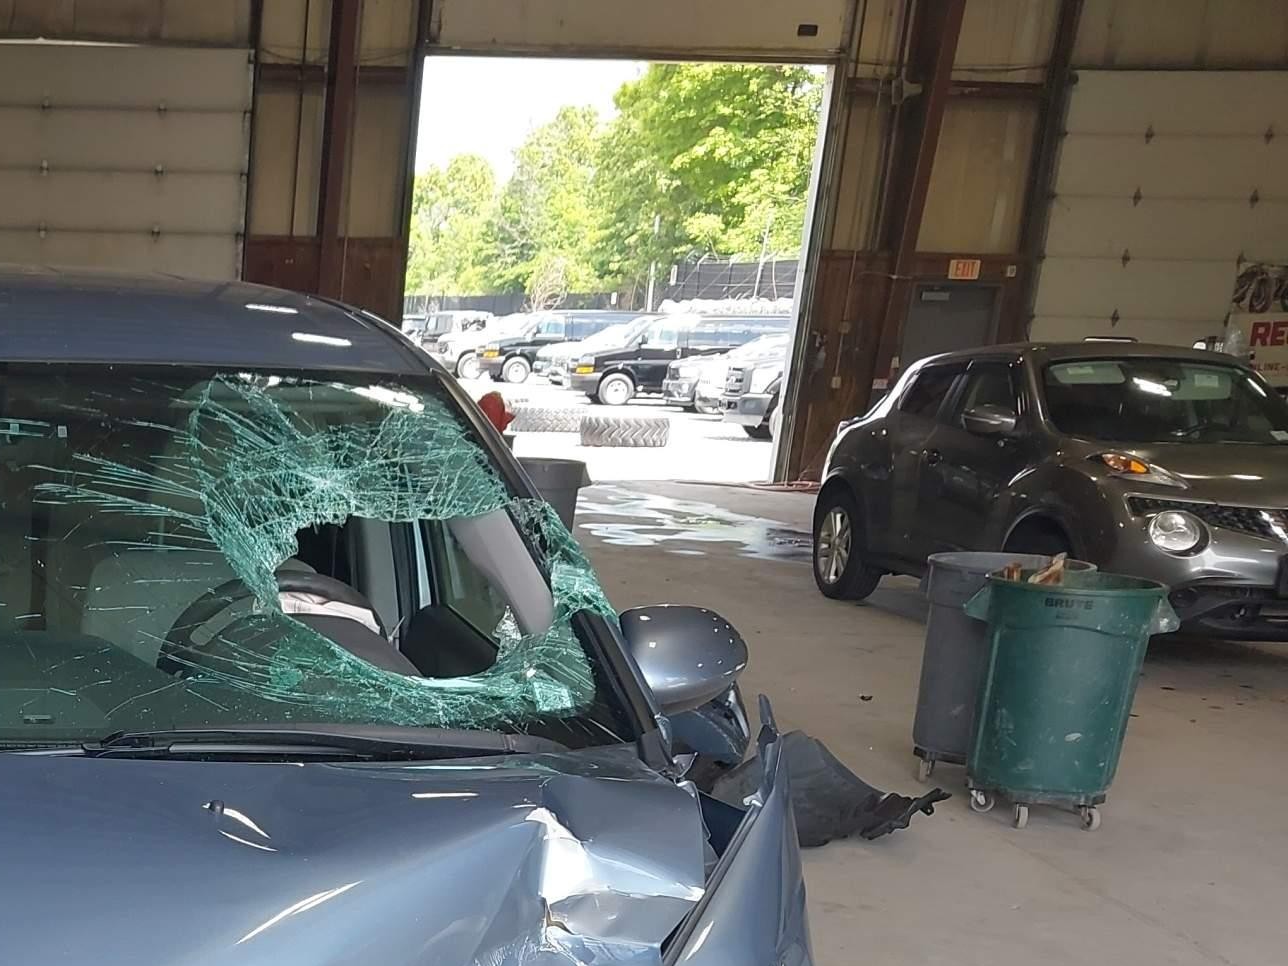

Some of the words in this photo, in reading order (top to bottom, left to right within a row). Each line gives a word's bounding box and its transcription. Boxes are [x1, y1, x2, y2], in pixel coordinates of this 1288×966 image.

[954, 261, 978, 277] EXIT
[1249, 321, 1288, 346] RE
[1045, 597, 1093, 610] BRUTE
